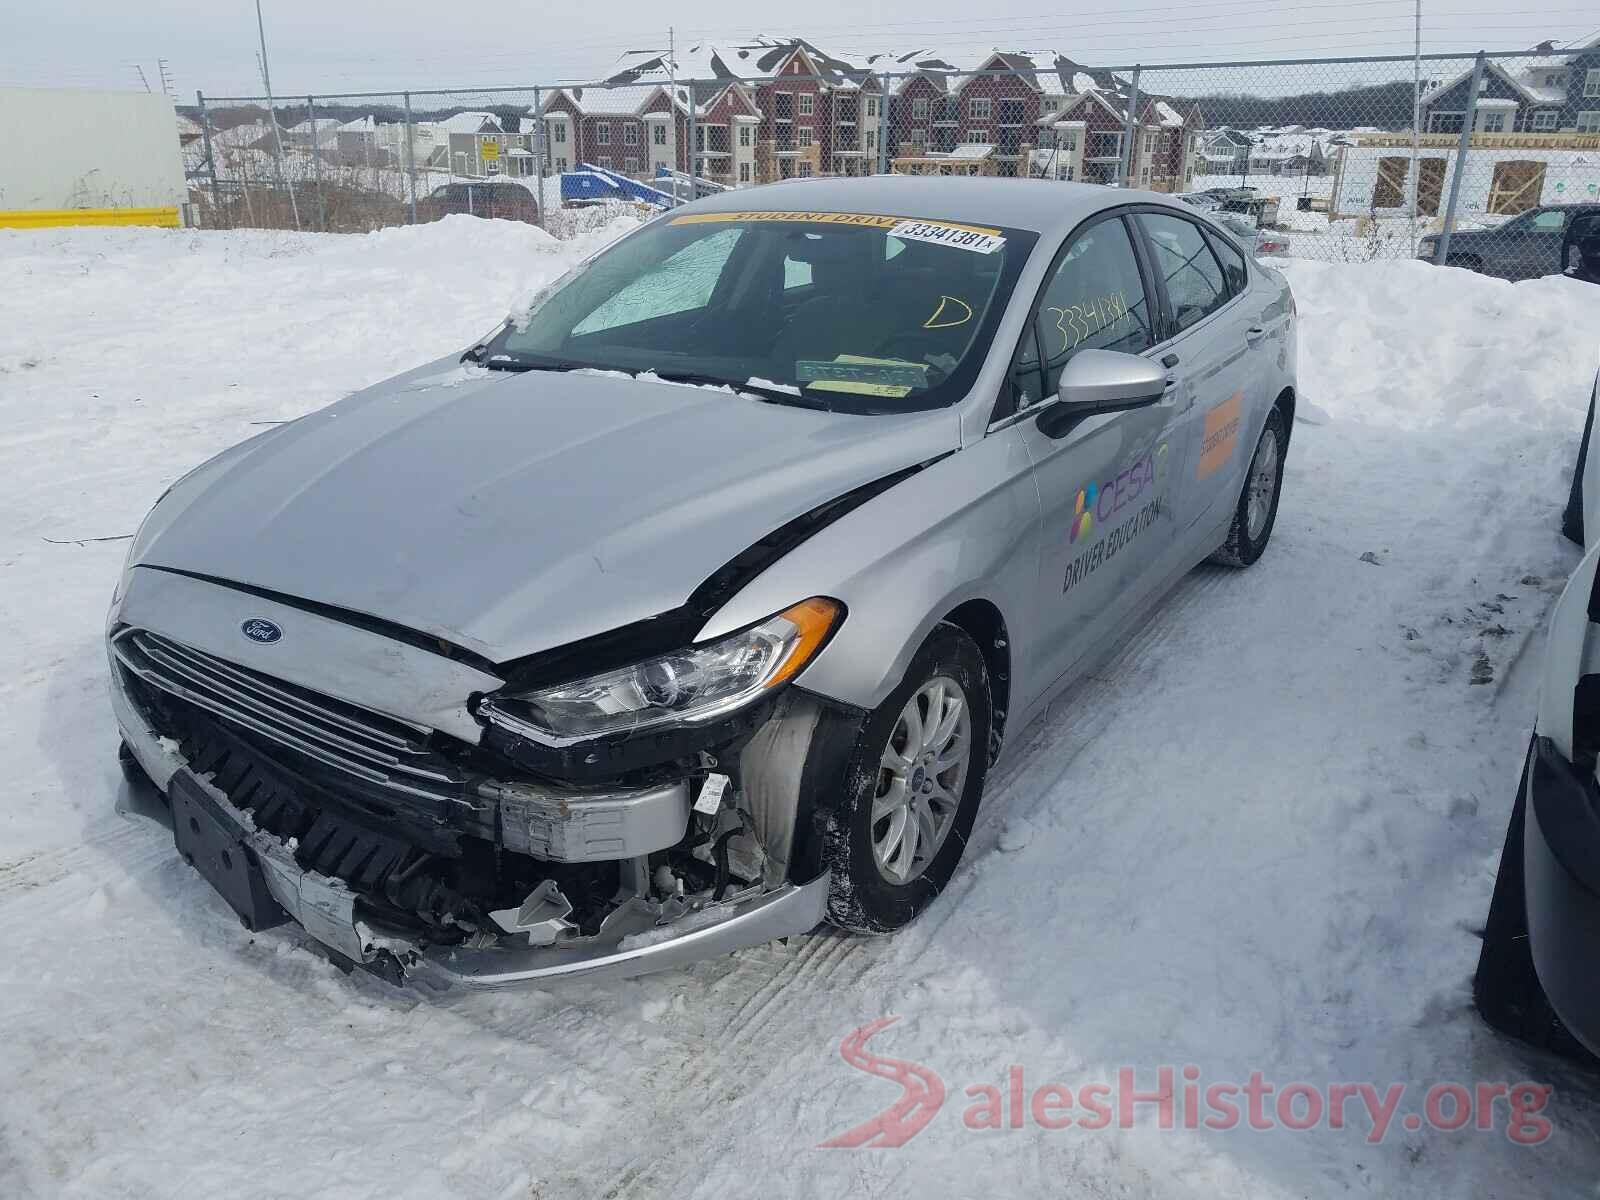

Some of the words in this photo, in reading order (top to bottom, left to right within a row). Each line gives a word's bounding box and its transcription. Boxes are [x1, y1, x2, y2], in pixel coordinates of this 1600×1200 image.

[735, 212, 831, 221] STUDENT
[922, 295, 973, 329] D
[1047, 290, 1132, 352] 33341381
[1096, 453, 1155, 524] CESA
[1063, 539, 1105, 595] DRIVER
[1105, 495, 1163, 562] EDUCATION
[246, 621, 274, 640] Ford
